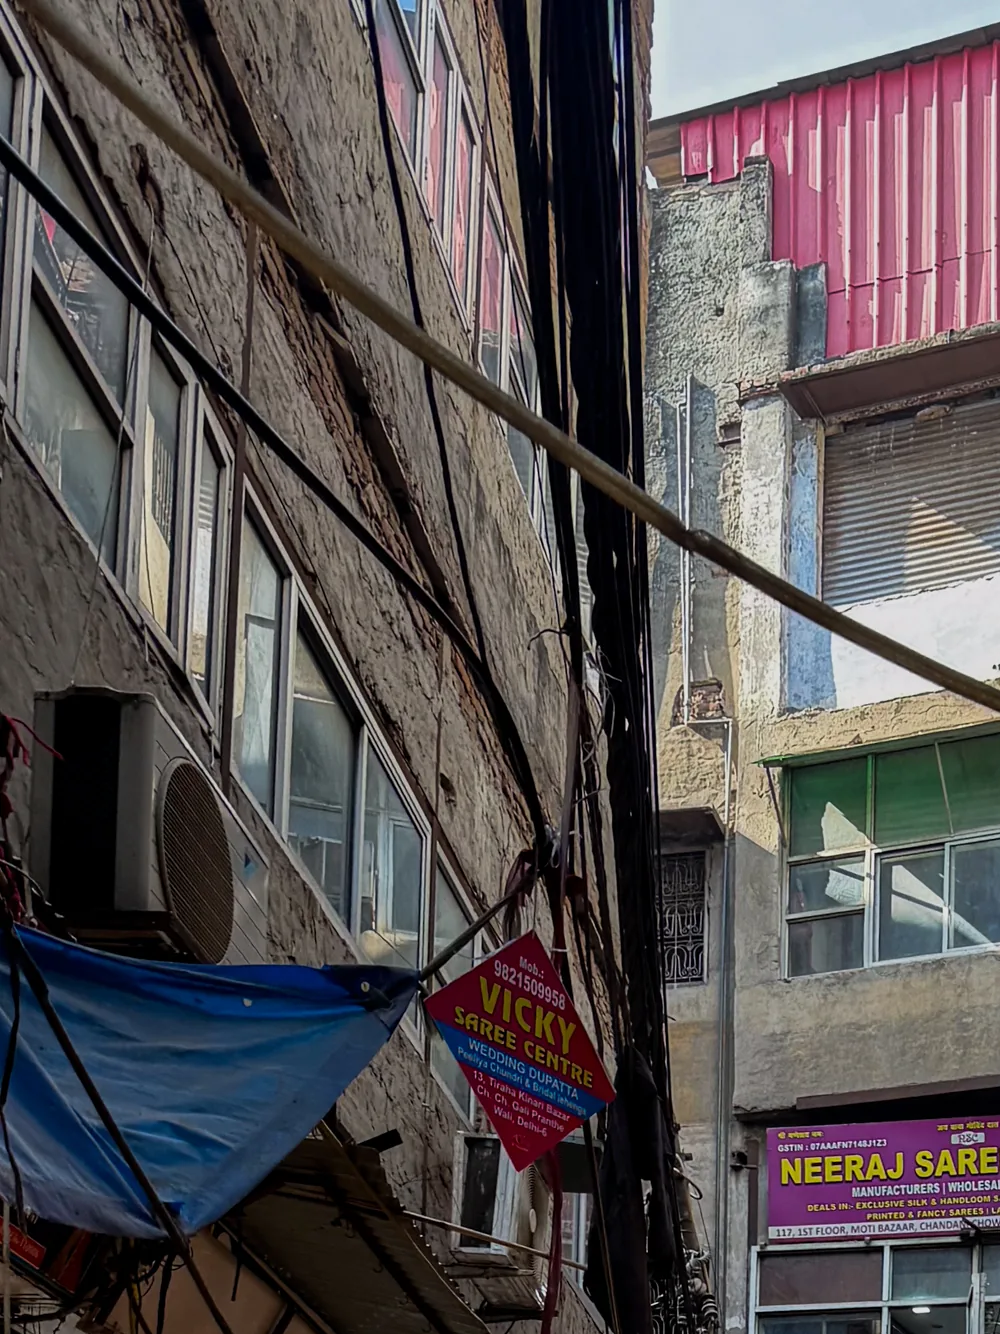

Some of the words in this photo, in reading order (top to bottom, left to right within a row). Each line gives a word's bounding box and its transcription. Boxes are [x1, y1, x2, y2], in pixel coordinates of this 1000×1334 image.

[494, 960, 566, 1010] 9821509958
[479, 976, 576, 1055] VICKY
[455, 1006, 517, 1050] SAREE
[523, 1040, 593, 1088] CENTRE
[469, 1037, 526, 1075] WEDDING
[529, 1065, 579, 1100] DUPATTA
[489, 1075, 517, 1098] Tiraha
[518, 1089, 544, 1111] Kinari
[546, 1104, 571, 1123] Bazar
[533, 1081, 557, 1102] Bridal
[517, 1117, 548, 1138] Delhi-6
[532, 1109, 565, 1133] Pranthe
[777, 1143, 803, 1152] GSTIN
[781, 1152, 904, 1185] NEERAJ
[851, 1182, 940, 1198] MANUFACTURERS
[807, 1203, 836, 1212] DEALS
[855, 1200, 905, 1210] EXCLUSIVE
[907, 1199, 928, 1207] SILK
[931, 1198, 937, 1206] &
[940, 1195, 991, 1205] HANDLOOM
[866, 1211, 905, 1220] PRINTED
[908, 1211, 914, 1219] &
[917, 1209, 946, 1218] FANCY
[949, 1207, 984, 1217] SAREES
[776, 1228, 795, 1238] 117,
[798, 1228, 813, 1236] 1ST
[816, 1226, 849, 1236] FLOOR,
[851, 1225, 876, 1234] MOTI
[878, 1222, 917, 1233] BAZAAR,
